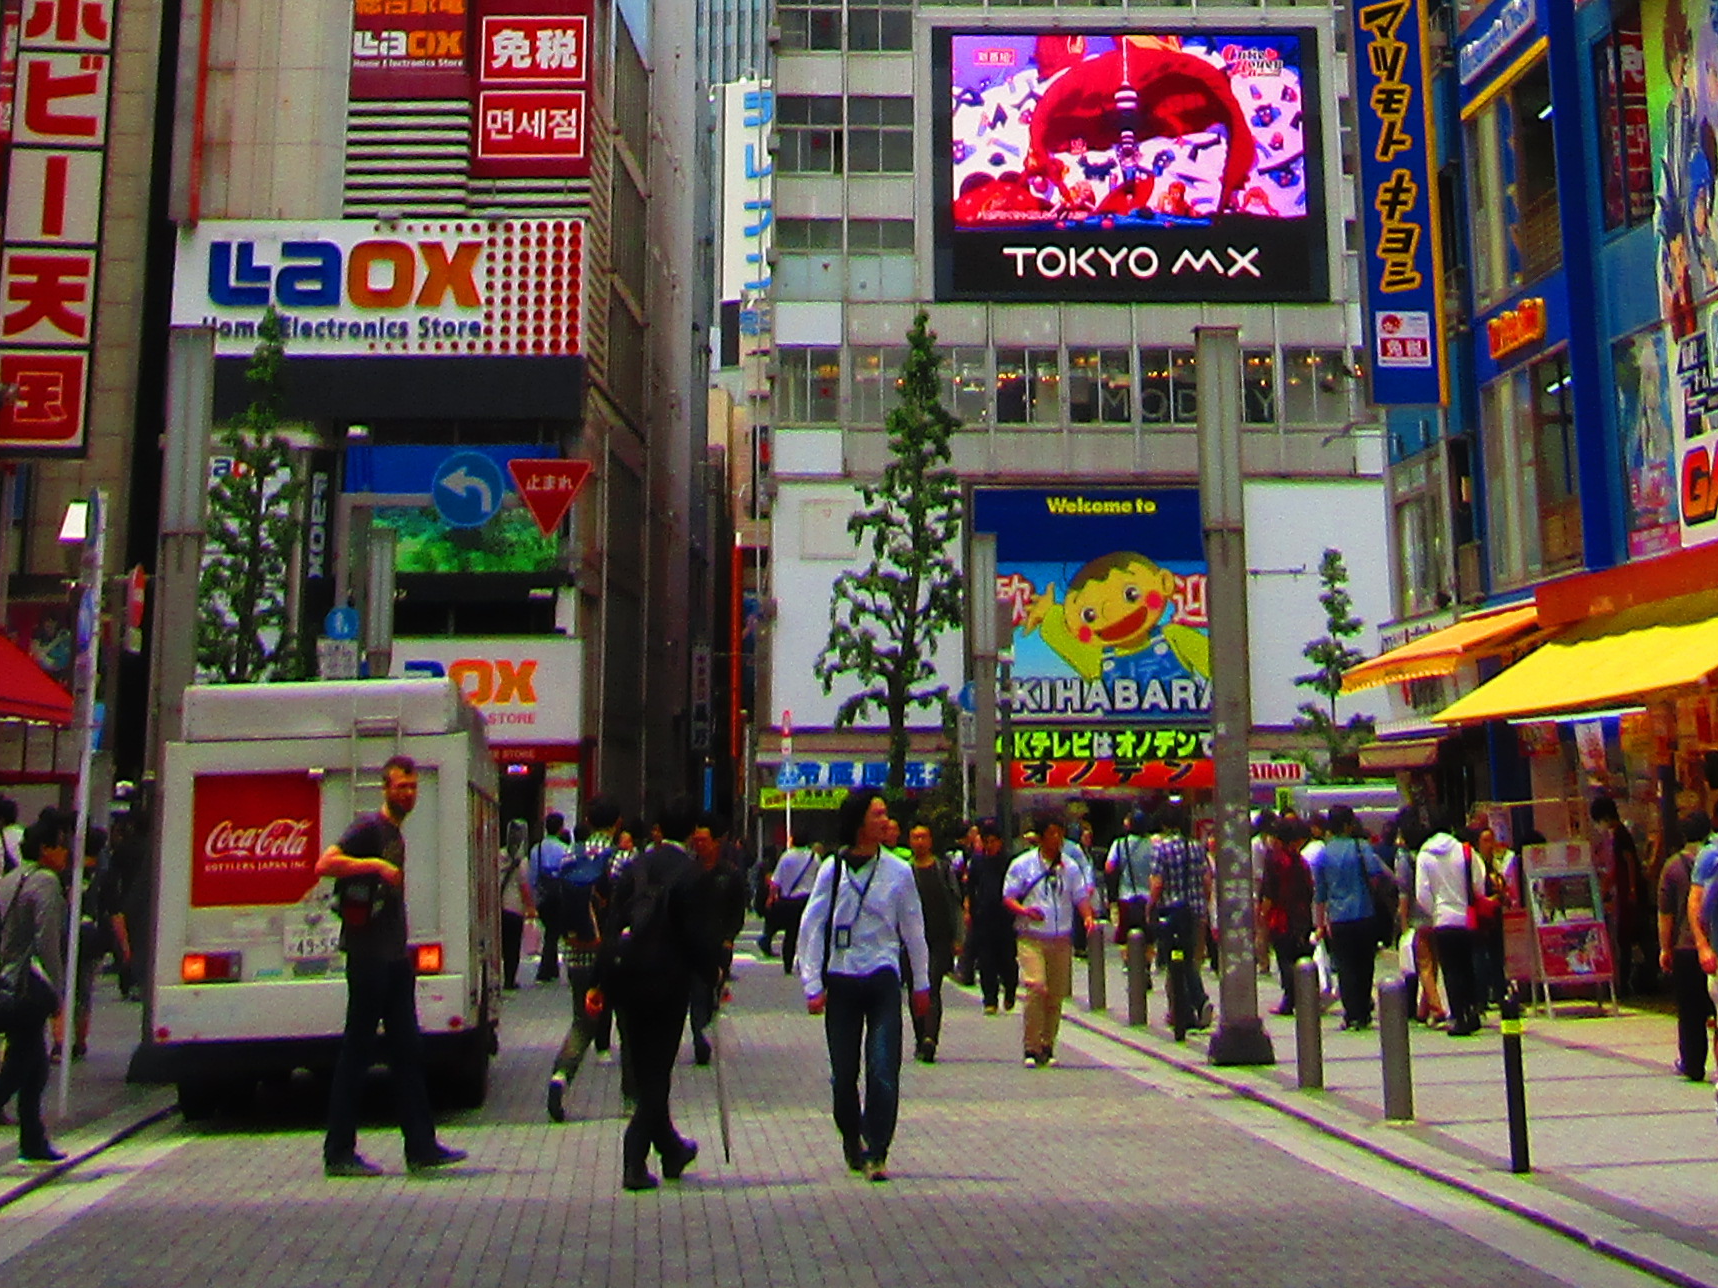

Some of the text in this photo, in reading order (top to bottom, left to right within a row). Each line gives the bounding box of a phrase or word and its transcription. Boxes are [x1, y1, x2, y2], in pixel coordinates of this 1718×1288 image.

[490, 29, 579, 72] 免税
[486, 105, 579, 142] 면세점
[1002, 246, 1263, 279] TOKYO MX
[281, 315, 409, 341] Electronics
[417, 315, 482, 341] Store
[524, 473, 573, 494] 止まれ
[1046, 496, 1156, 516] Welcome to
[204, 817, 310, 860] Coca-Cola
